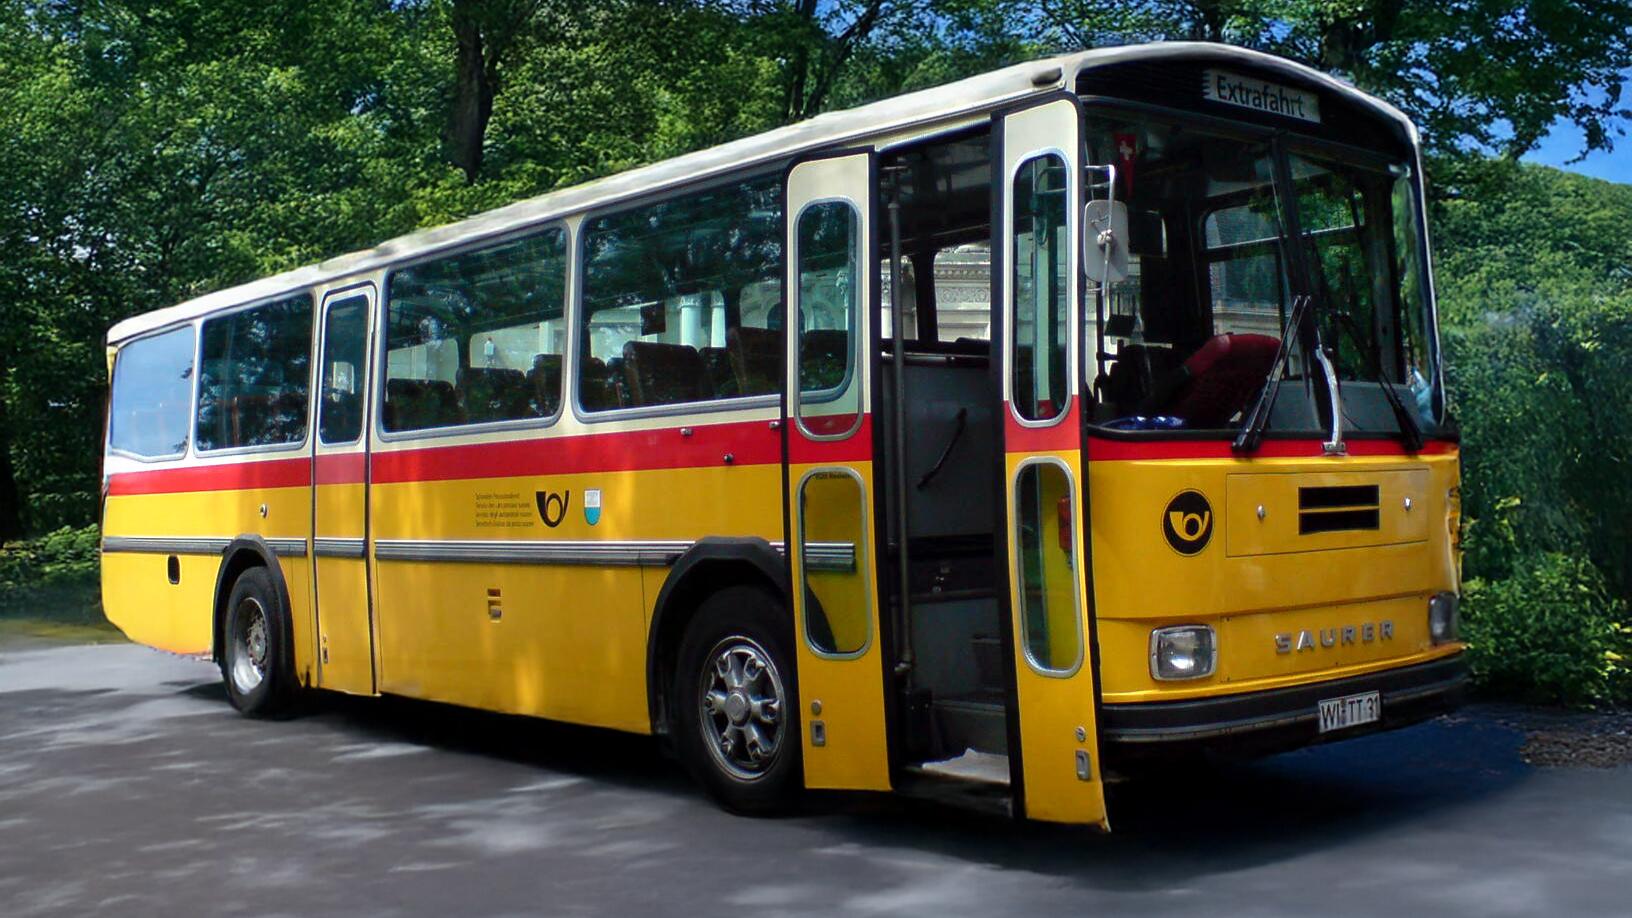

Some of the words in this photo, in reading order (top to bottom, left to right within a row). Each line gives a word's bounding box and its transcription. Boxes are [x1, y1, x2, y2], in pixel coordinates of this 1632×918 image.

[1216, 75, 1305, 118] Extrafahrt
[1275, 619, 1394, 654] SAURER
[1348, 699, 1363, 723] TT
